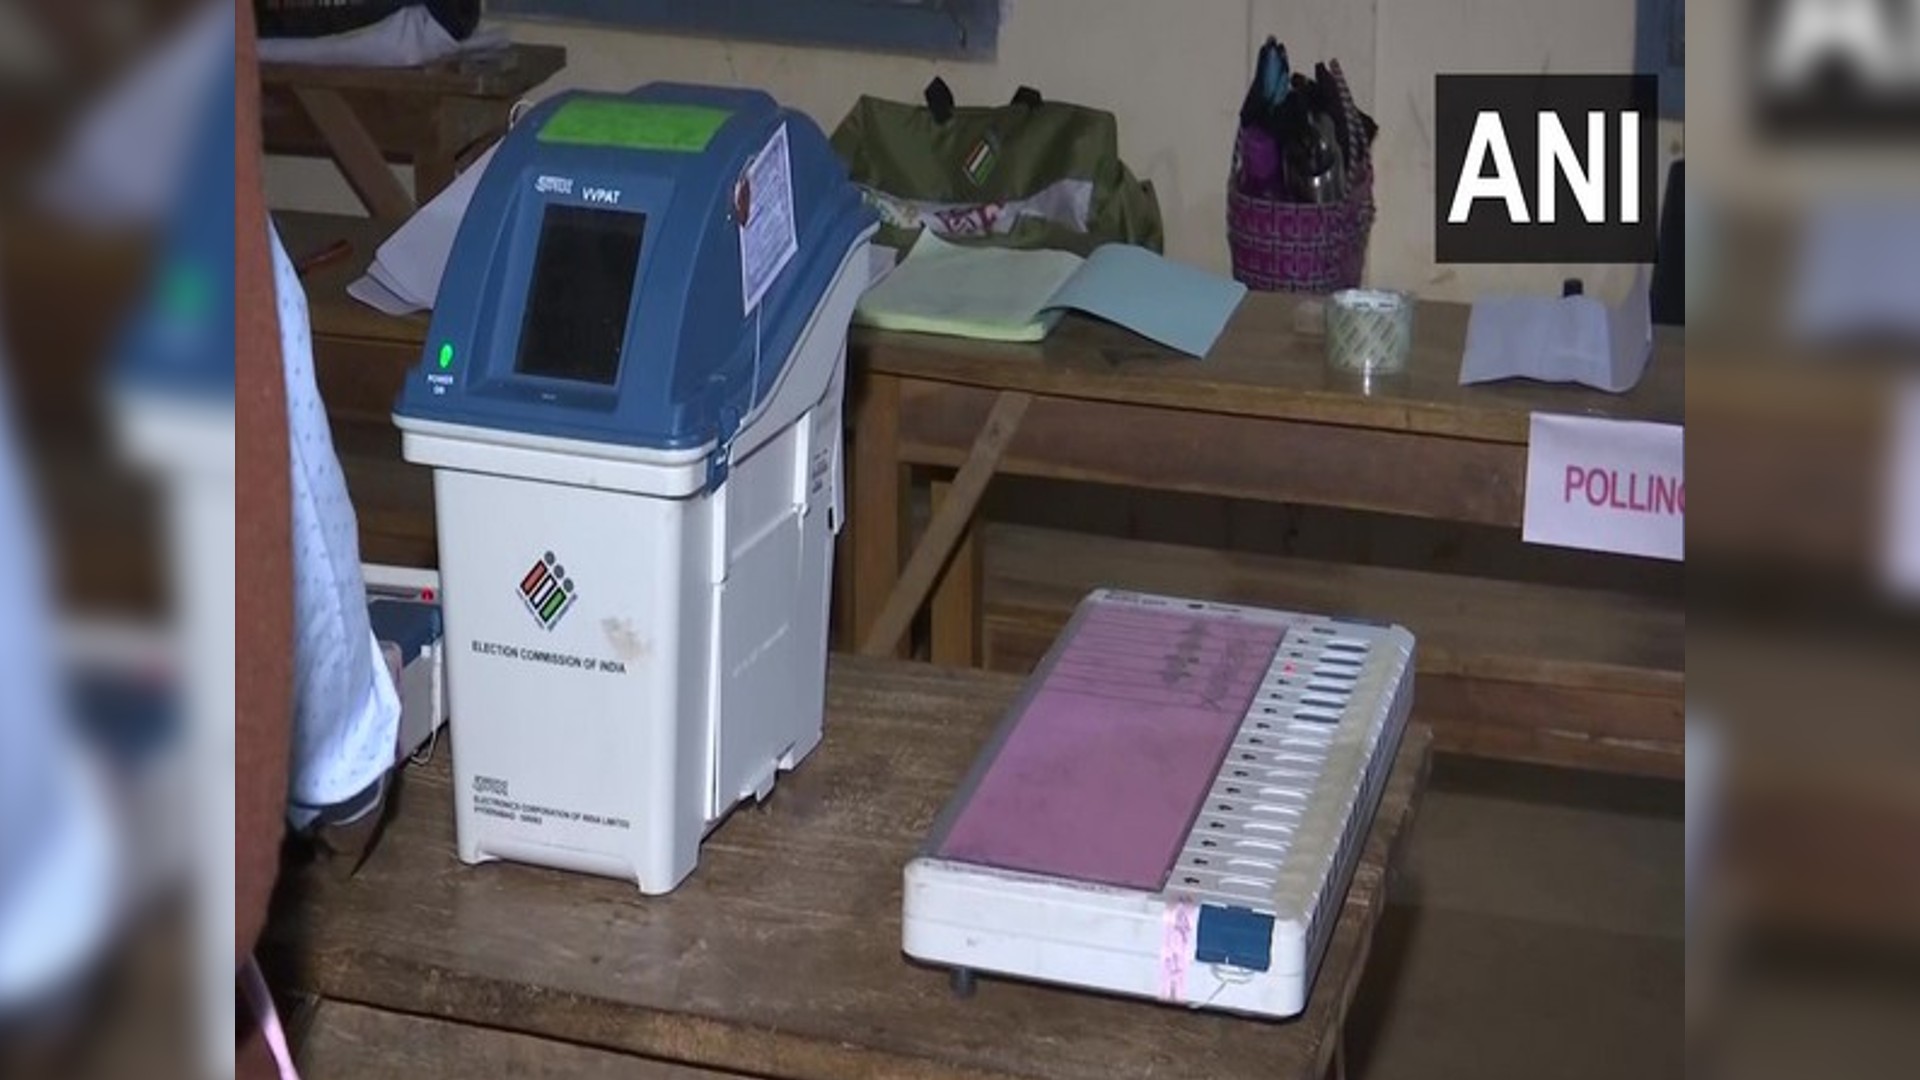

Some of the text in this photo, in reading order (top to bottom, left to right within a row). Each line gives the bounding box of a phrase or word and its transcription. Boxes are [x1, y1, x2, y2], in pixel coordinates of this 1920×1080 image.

[582, 186, 621, 204] VVPAT
[472, 640, 627, 674] ELECTION COMMISSION OF INDIA
